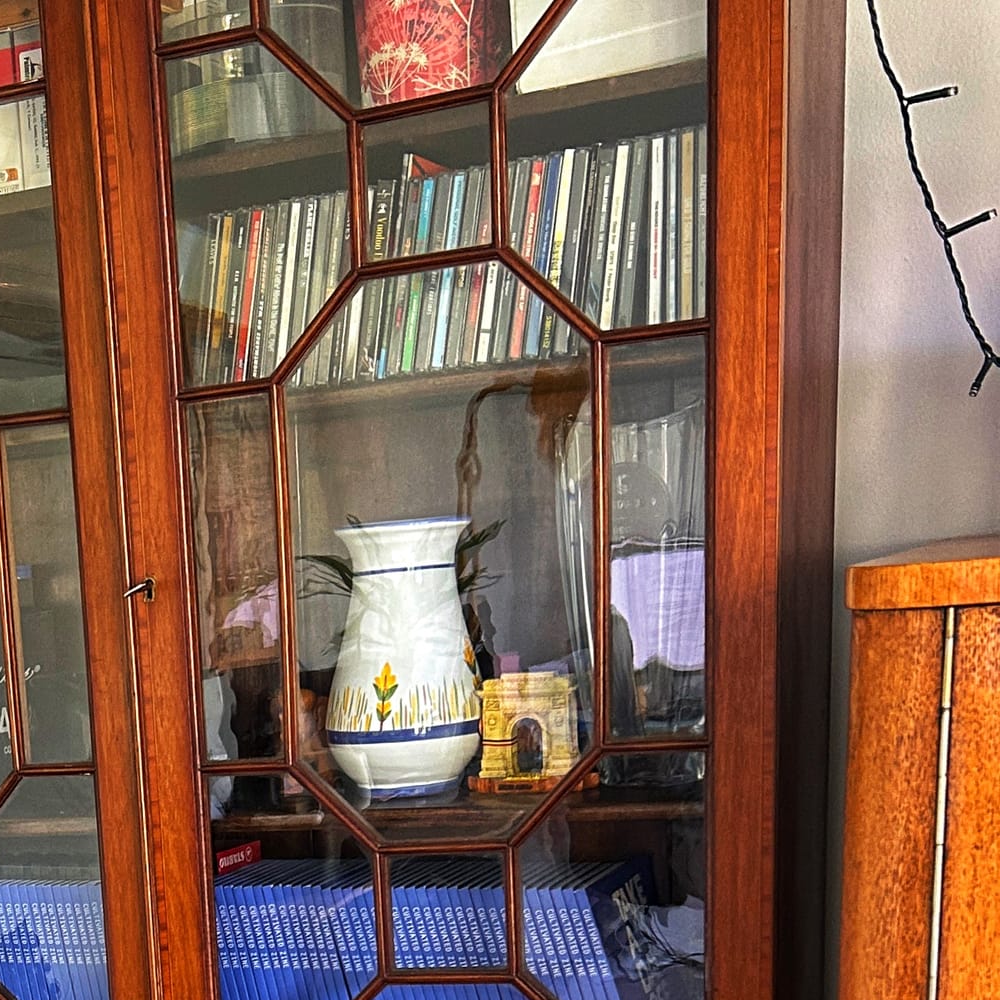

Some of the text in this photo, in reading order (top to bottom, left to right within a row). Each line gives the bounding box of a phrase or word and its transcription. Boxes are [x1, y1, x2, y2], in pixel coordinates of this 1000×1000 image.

[373, 216, 387, 250] Voodoo
[41, 903, 53, 944] CULTIVATED
[57, 903, 70, 944] CULTIVATED
[83, 903, 96, 945] CULTIVATED
[219, 905, 239, 969] CULTIVATED ZINE
[239, 905, 259, 969] CULTIVATED ZINE
[259, 905, 280, 969] CULTIVATED ZINE
[268, 904, 289, 968] CULTIVATED ZINE
[289, 905, 310, 969] CULTIVATED ZINE
[402, 907, 420, 952] CULTIVATED
[424, 907, 441, 952] CULTIVATED
[445, 907, 463, 952] CULTIVATED
[535, 910, 561, 977] CULTIVATED ZINE
[547, 909, 573, 977] CULTIVATED ZINE
[560, 908, 586, 977] CULTIVATED ZINE
[570, 909, 597, 977] CULTIVATED ZINE
[582, 909, 609, 977] CULTIVATED ZINE
